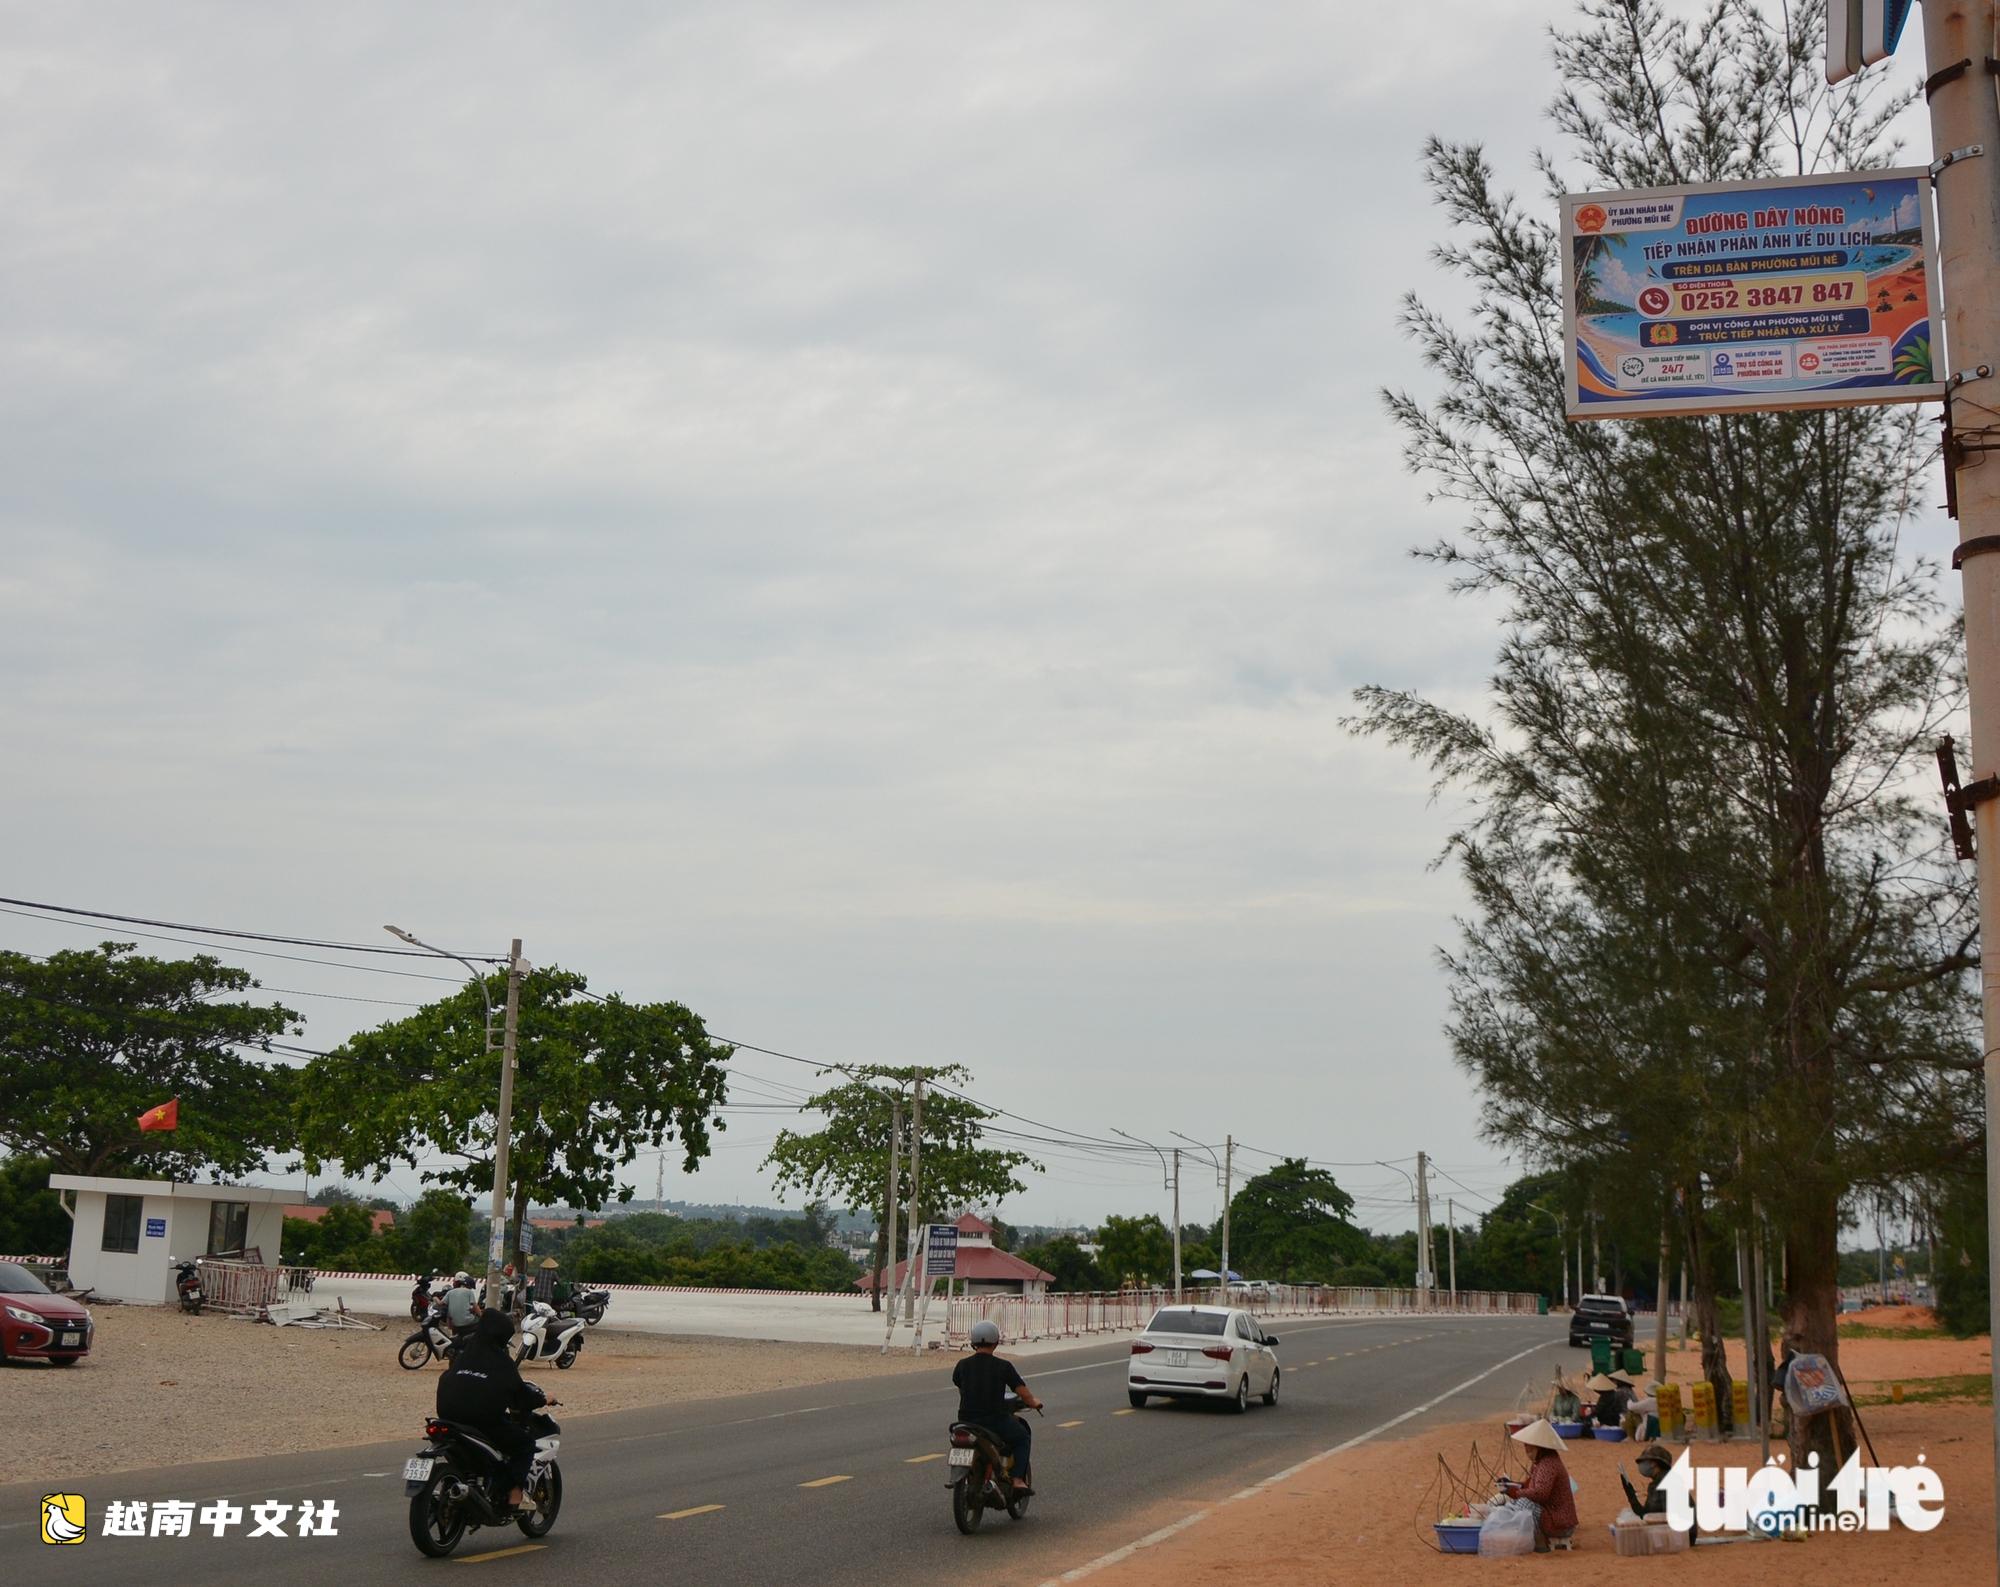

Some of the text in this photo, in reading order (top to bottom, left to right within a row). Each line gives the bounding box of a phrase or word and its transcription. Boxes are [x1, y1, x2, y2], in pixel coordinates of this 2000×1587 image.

[1637, 205, 1656, 214] NHÂN
[1659, 204, 1673, 212] DÂN
[1612, 214, 1671, 226] PHƯỜNG MŨI NÉ
[1686, 205, 1844, 234] ĐƯỜNG DÂY NÓNG
[1644, 240, 1672, 260] TIẾP
[1678, 239, 1716, 256] NHẬN
[1721, 233, 1758, 251] PHẢN
[1763, 232, 1790, 248] ÁNH
[1817, 233, 1834, 246] DU
[1840, 232, 1870, 248] LỊCH
[1673, 255, 1838, 276] TRÊN ĐỊA BÀN PHƯỜNG MŨI NÉ
[1681, 282, 1854, 311] 0252 3847 847
[1690, 323, 1710, 331] ĐƠN
[1724, 320, 1750, 328] CÔNG
[1769, 317, 1808, 325] PHƯỜNG
[1699, 324, 1839, 342] TRỰC TIẾP NHẬN VÀ XỬ LÝ
[1662, 364, 1684, 374] 24/7
